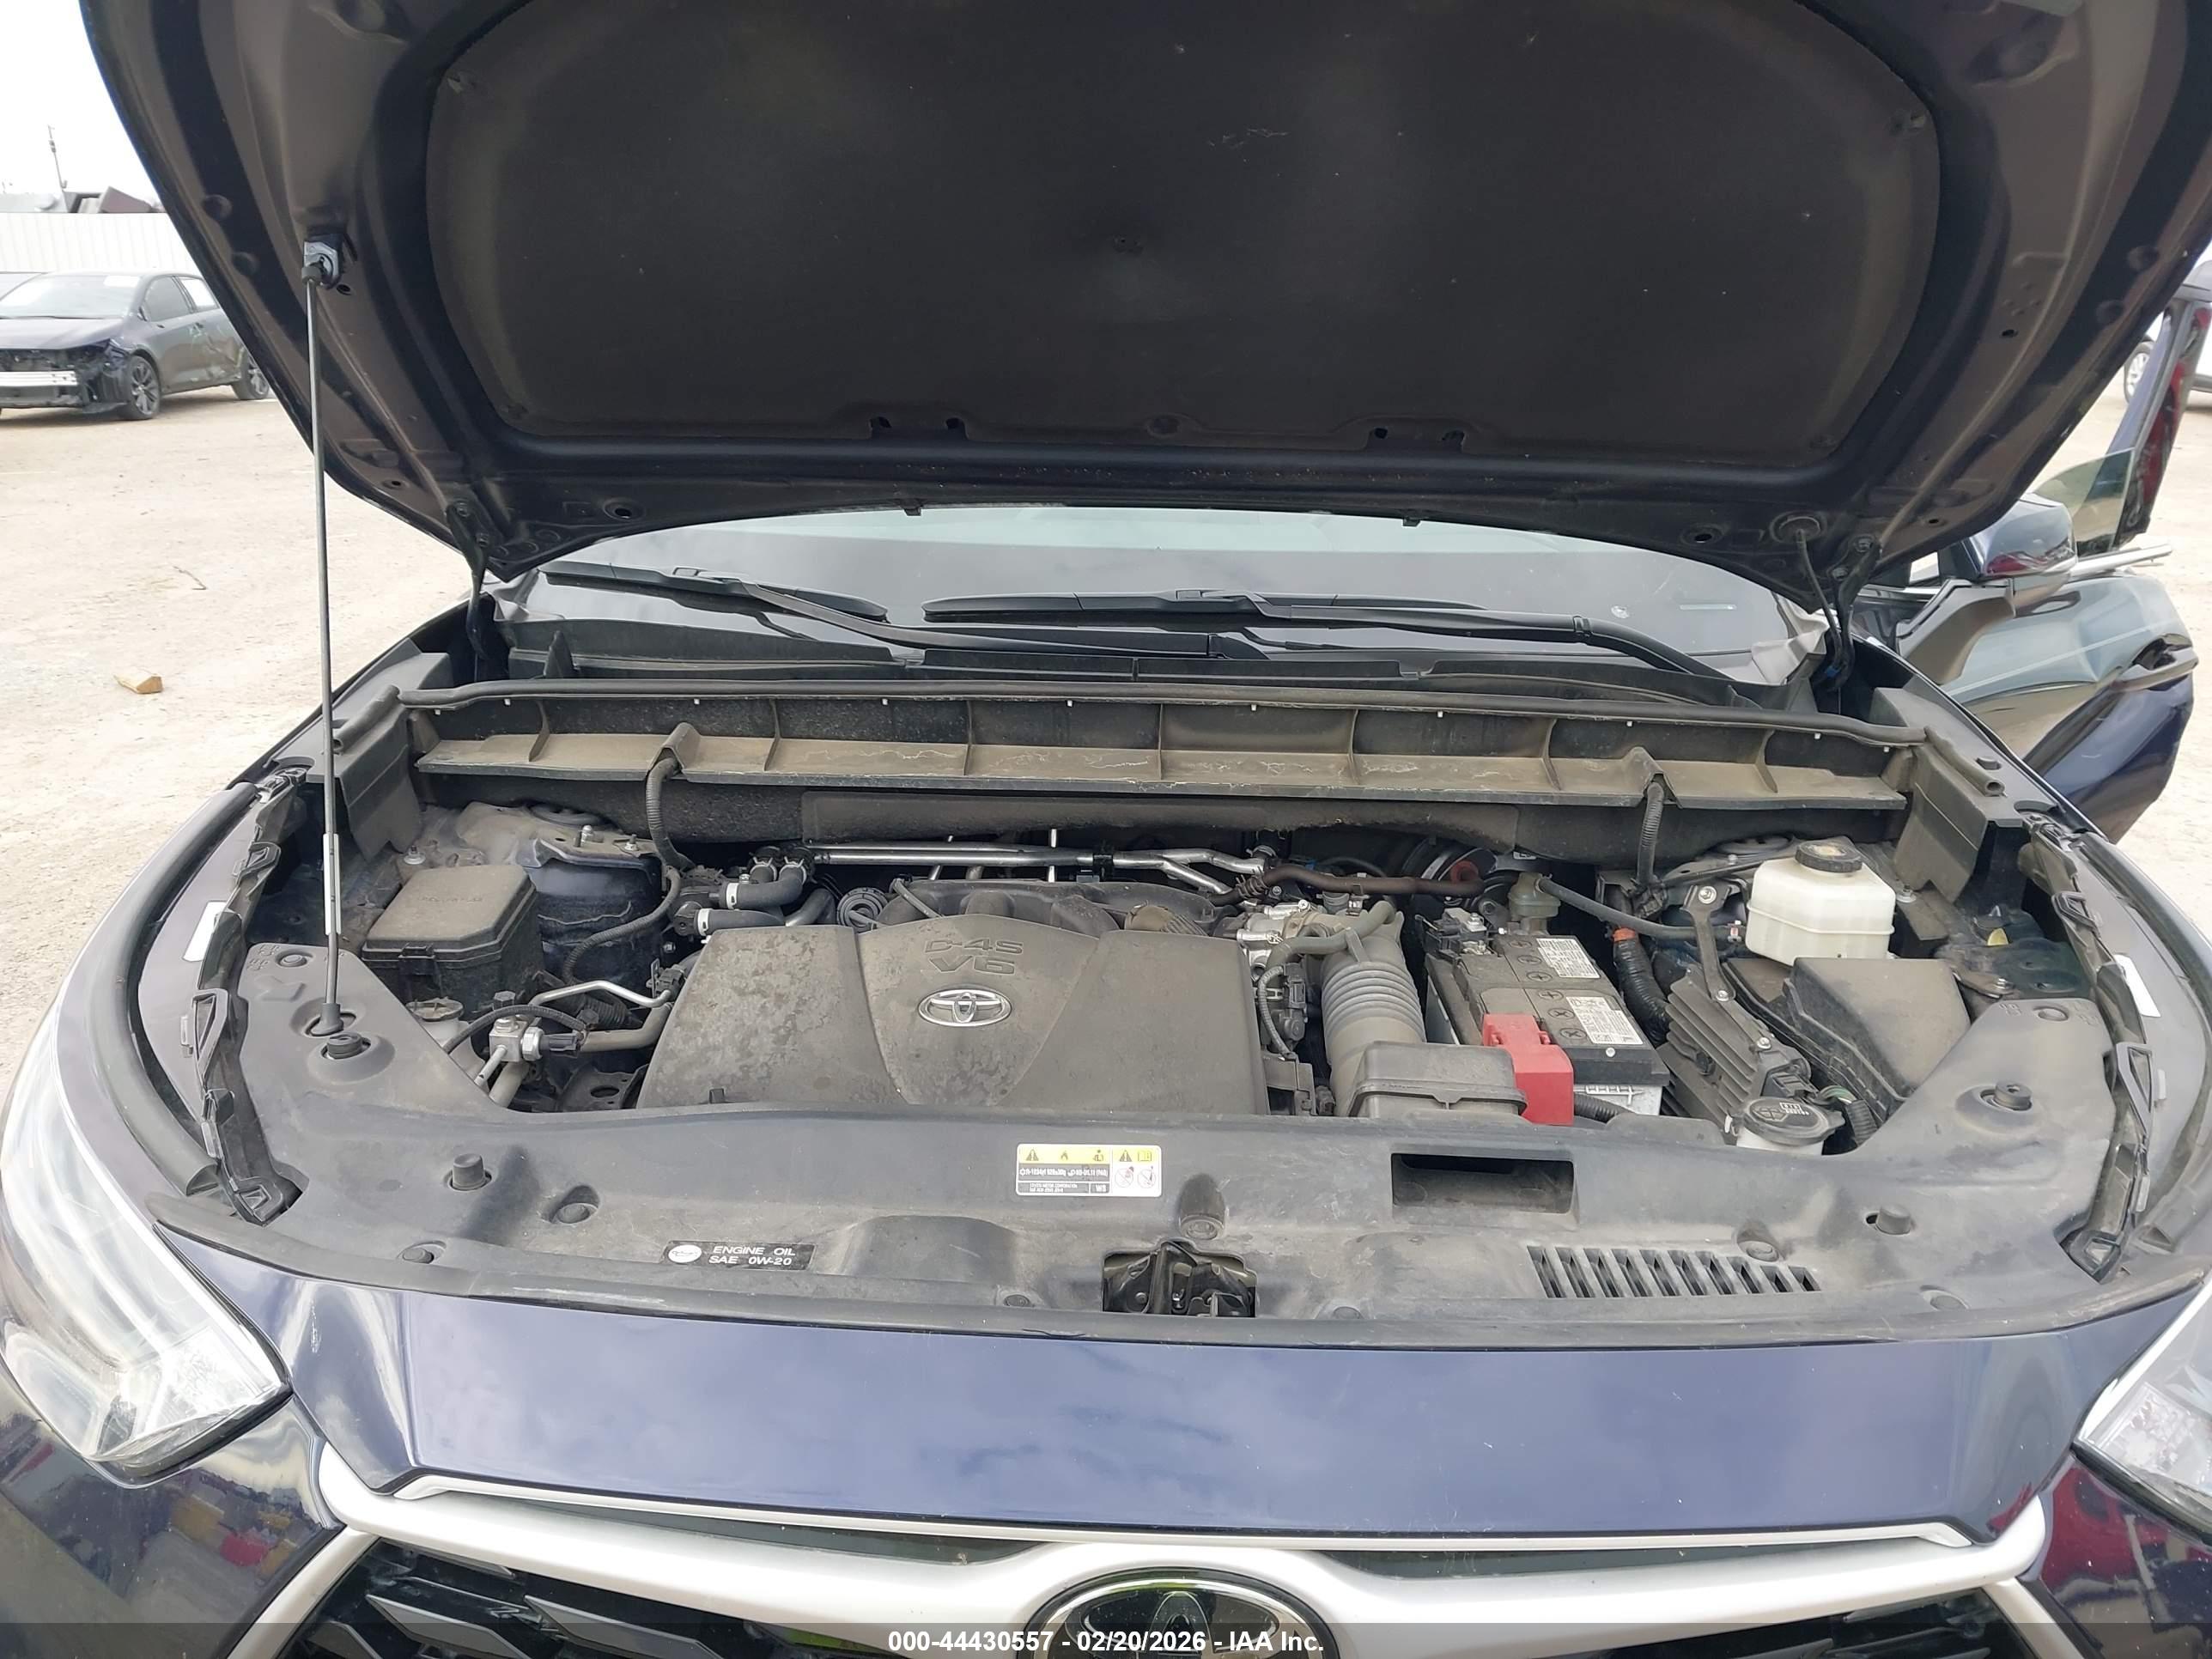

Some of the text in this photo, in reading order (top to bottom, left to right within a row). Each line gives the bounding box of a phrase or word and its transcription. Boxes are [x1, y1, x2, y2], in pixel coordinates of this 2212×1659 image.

[928, 955, 1016, 975] V6
[713, 1245, 796, 1256] ENGINE OIL
[708, 1255, 793, 1266] SAE 0W-20
